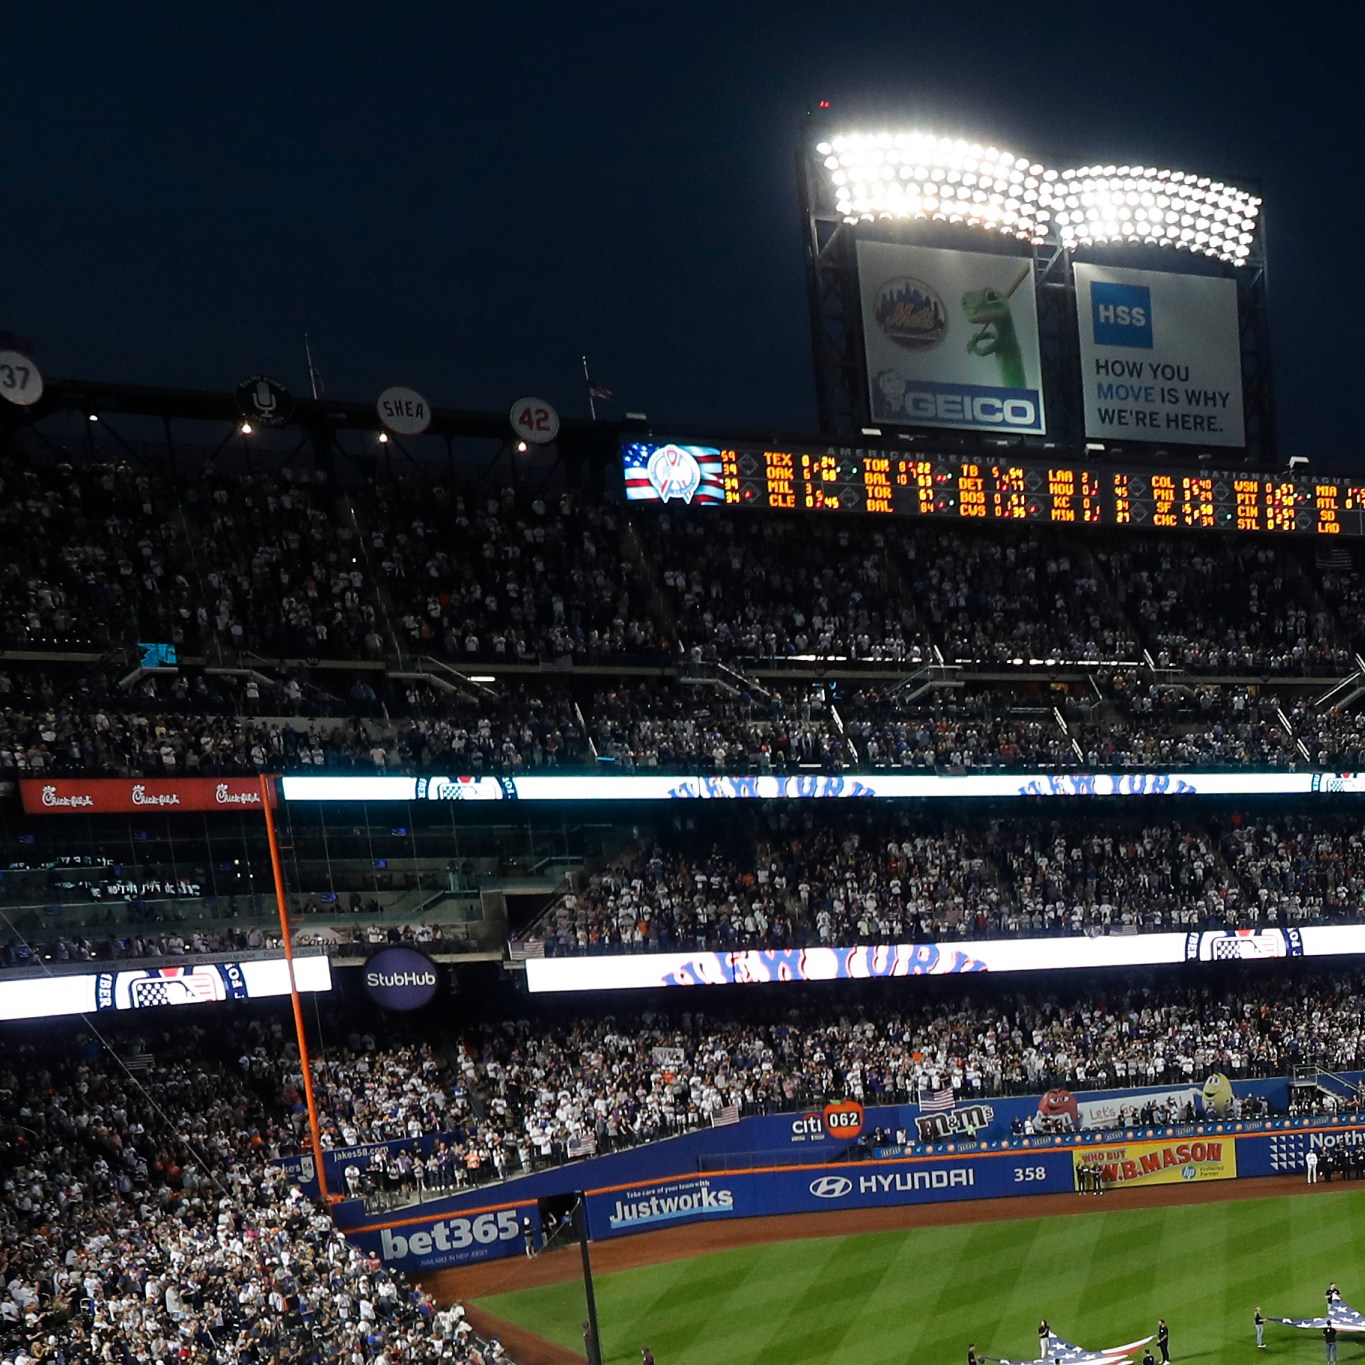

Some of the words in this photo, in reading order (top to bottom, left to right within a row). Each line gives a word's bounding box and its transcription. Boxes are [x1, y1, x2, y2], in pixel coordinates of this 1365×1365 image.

[1099, 306, 1146, 327] HSS
[0, 364, 30, 390] 37
[1095, 359, 1143, 380] HOW
[1148, 362, 1189, 382] YOU
[1097, 382, 1154, 403] MOVE
[1160, 387, 1178, 405] IS
[1185, 391, 1230, 409] WHY
[383, 401, 424, 420] SHEA
[904, 391, 1035, 425] GEICO
[519, 408, 550, 431] 42
[1098, 407, 1160, 428] WE'RE
[1166, 411, 1224, 432] HERE.
[764, 452, 793, 467] TEX
[864, 471, 891, 485] BAL
[959, 477, 984, 491] DET
[1152, 474, 1175, 489] COL
[767, 480, 794, 494] MIL
[769, 494, 795, 508] CLE
[866, 499, 893, 513] BAL
[1053, 496, 1071, 509] KC
[1156, 501, 1173, 514] SF
[1237, 518, 1260, 531] STL
[367, 971, 436, 987] StubHub
[792, 1118, 822, 1134] citi
[829, 1113, 859, 1128] 062
[1081, 1150, 1105, 1164] WHO
[1106, 1148, 1128, 1161] BUT
[859, 1168, 975, 1194] HYUNDAI
[1014, 1166, 1047, 1182] 358
[609, 1187, 734, 1224] Justworks
[380, 1209, 520, 1261] bet365
